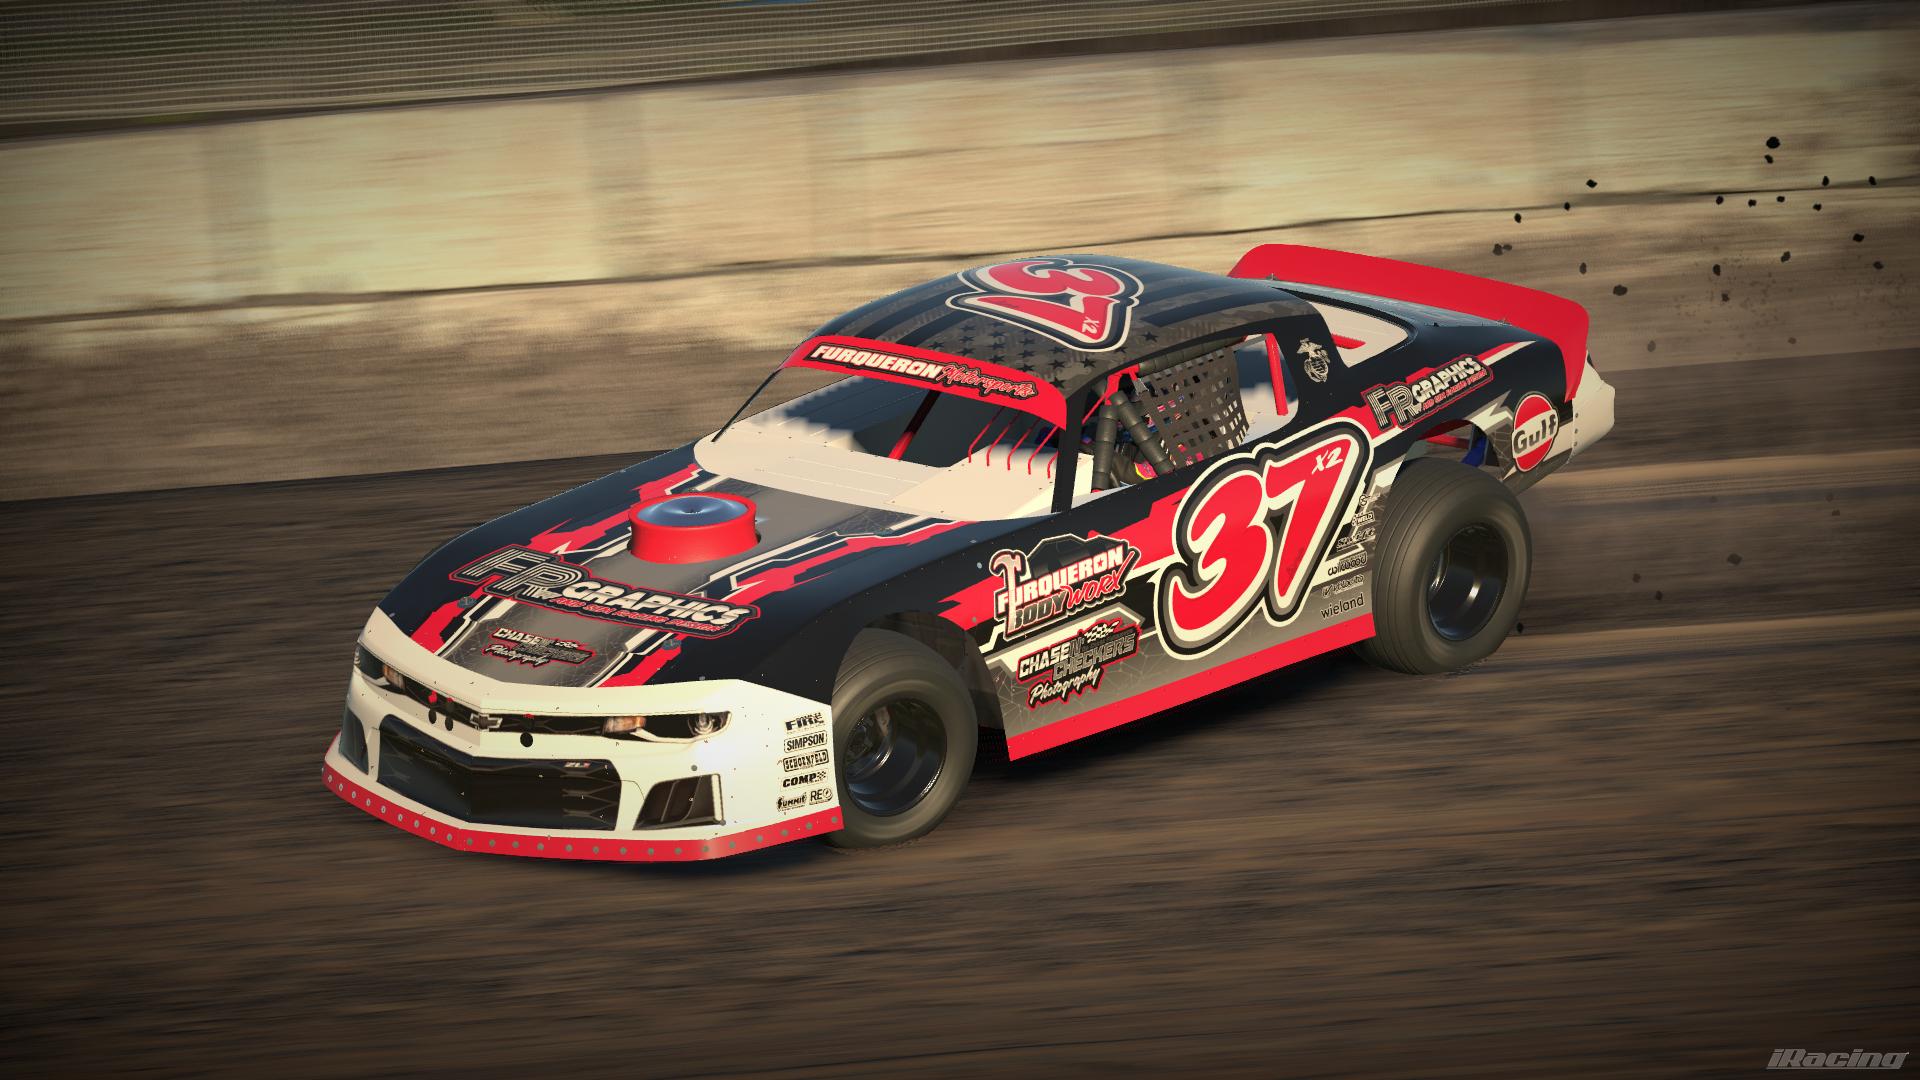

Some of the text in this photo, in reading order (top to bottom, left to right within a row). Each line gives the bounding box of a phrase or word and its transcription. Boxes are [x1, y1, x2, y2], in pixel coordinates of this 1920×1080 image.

[962, 257, 1128, 345] 37
[810, 345, 1036, 397] FURQUERON Motorsports
[1411, 357, 1482, 403] GRAPHICS
[1513, 413, 1557, 454] Gulf
[1311, 447, 1344, 475] X2
[1168, 433, 1360, 642] 37
[997, 545, 1124, 614] FURQUERON
[1014, 551, 1135, 630] BODY WORX
[562, 581, 750, 625] GRAPHICS
[1321, 593, 1364, 618] wieland
[1053, 633, 1136, 680] CHECKERS
[1029, 666, 1101, 704] Photography
[786, 732, 825, 751] SIMPSON
[782, 772, 817, 788] COMP
